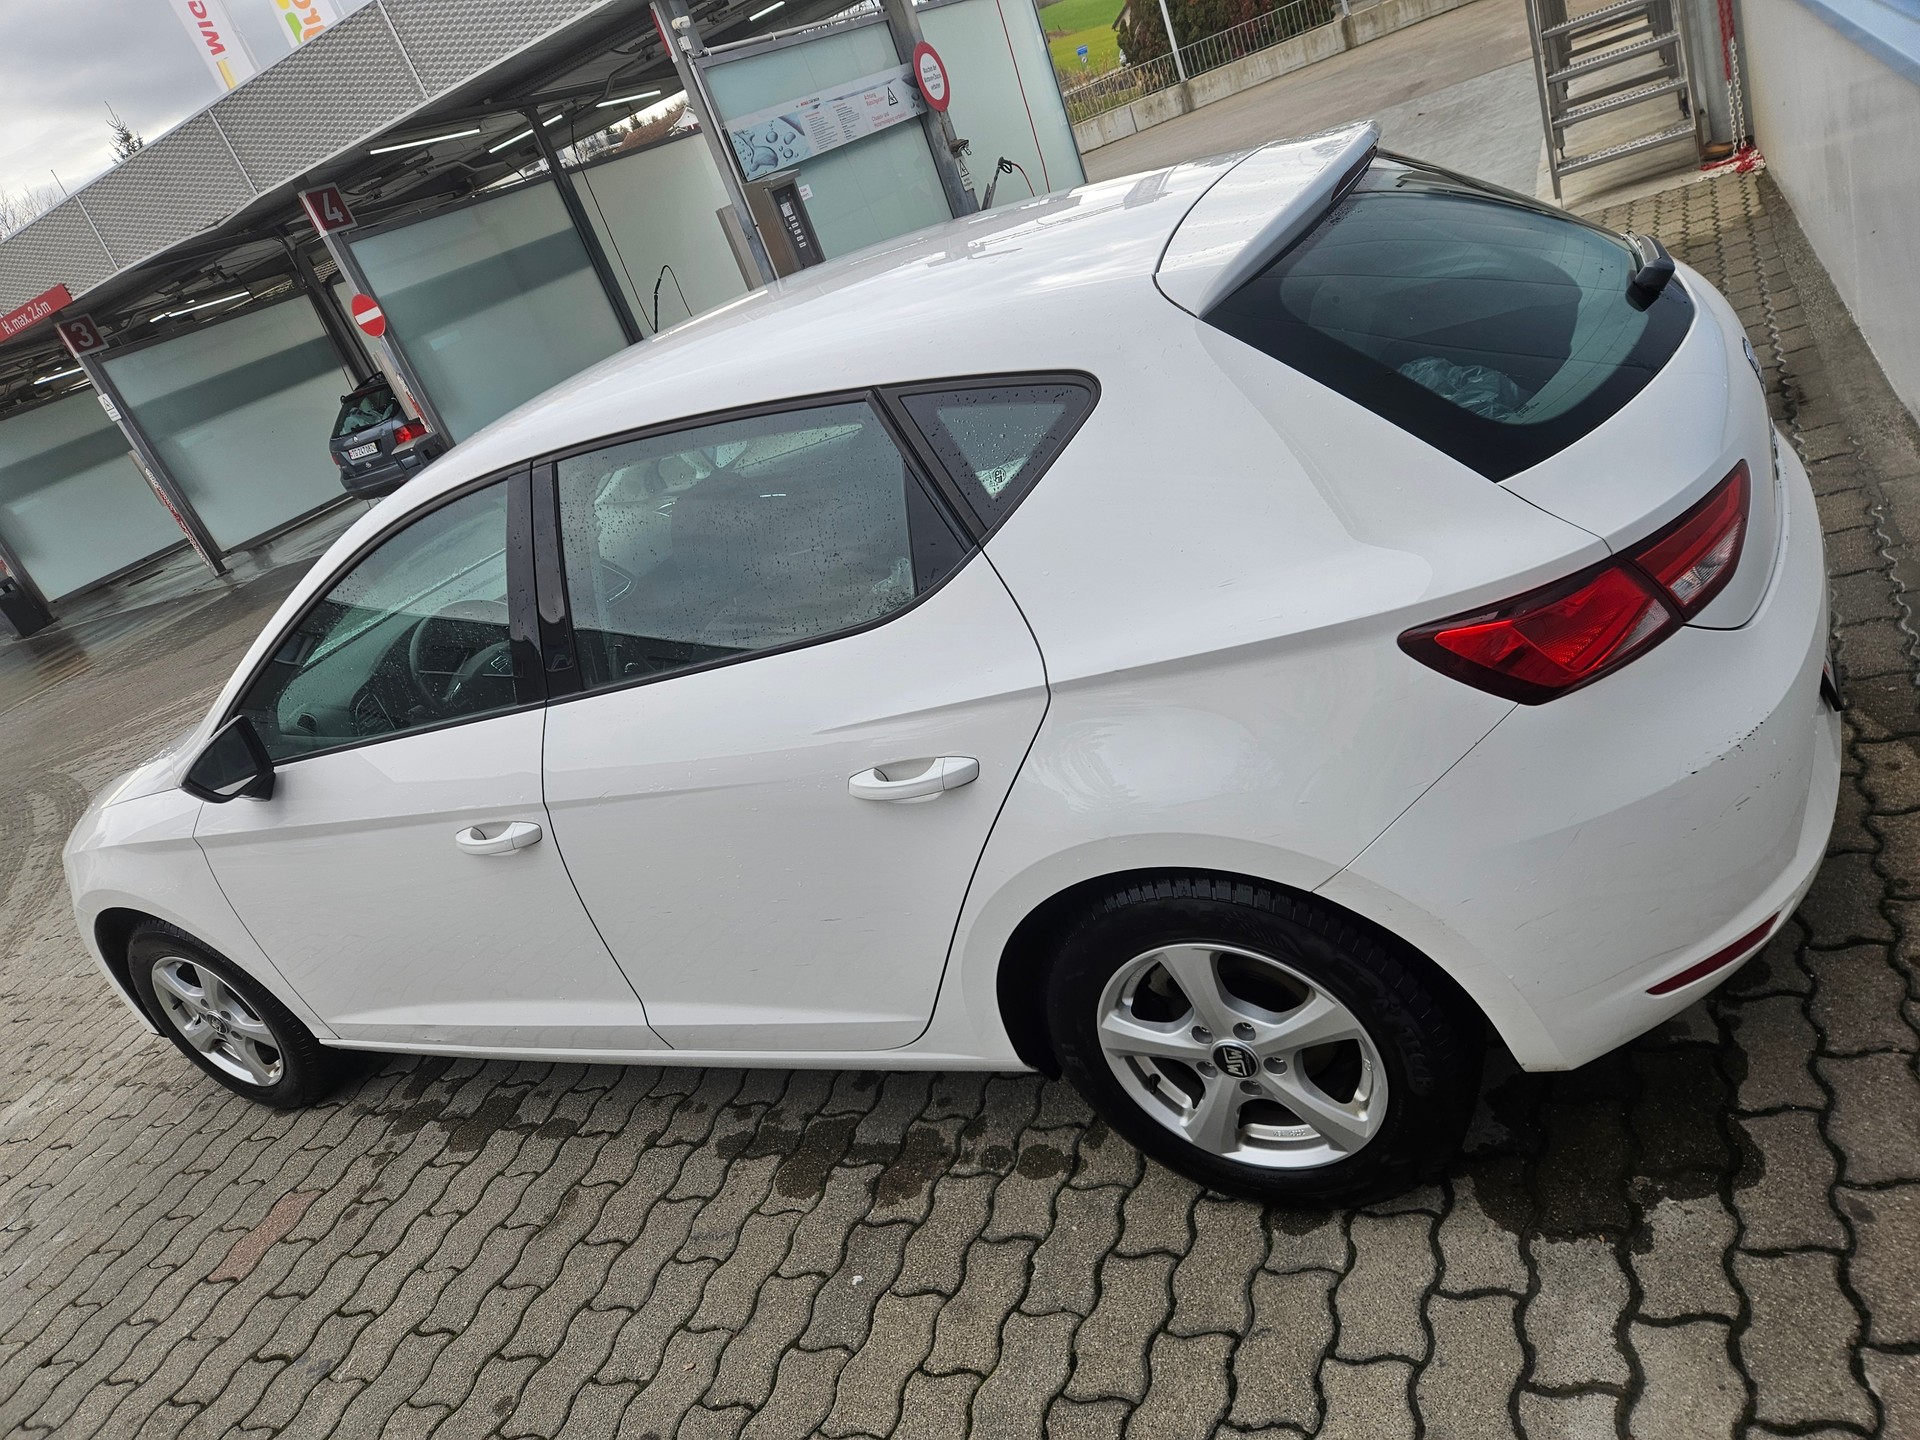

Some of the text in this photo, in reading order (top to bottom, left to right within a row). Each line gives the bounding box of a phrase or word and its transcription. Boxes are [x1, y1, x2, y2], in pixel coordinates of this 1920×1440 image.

[322, 192, 344, 222] 4
[1, 320, 14, 335] H.
[11, 313, 32, 330] max.
[70, 323, 94, 347] 3
